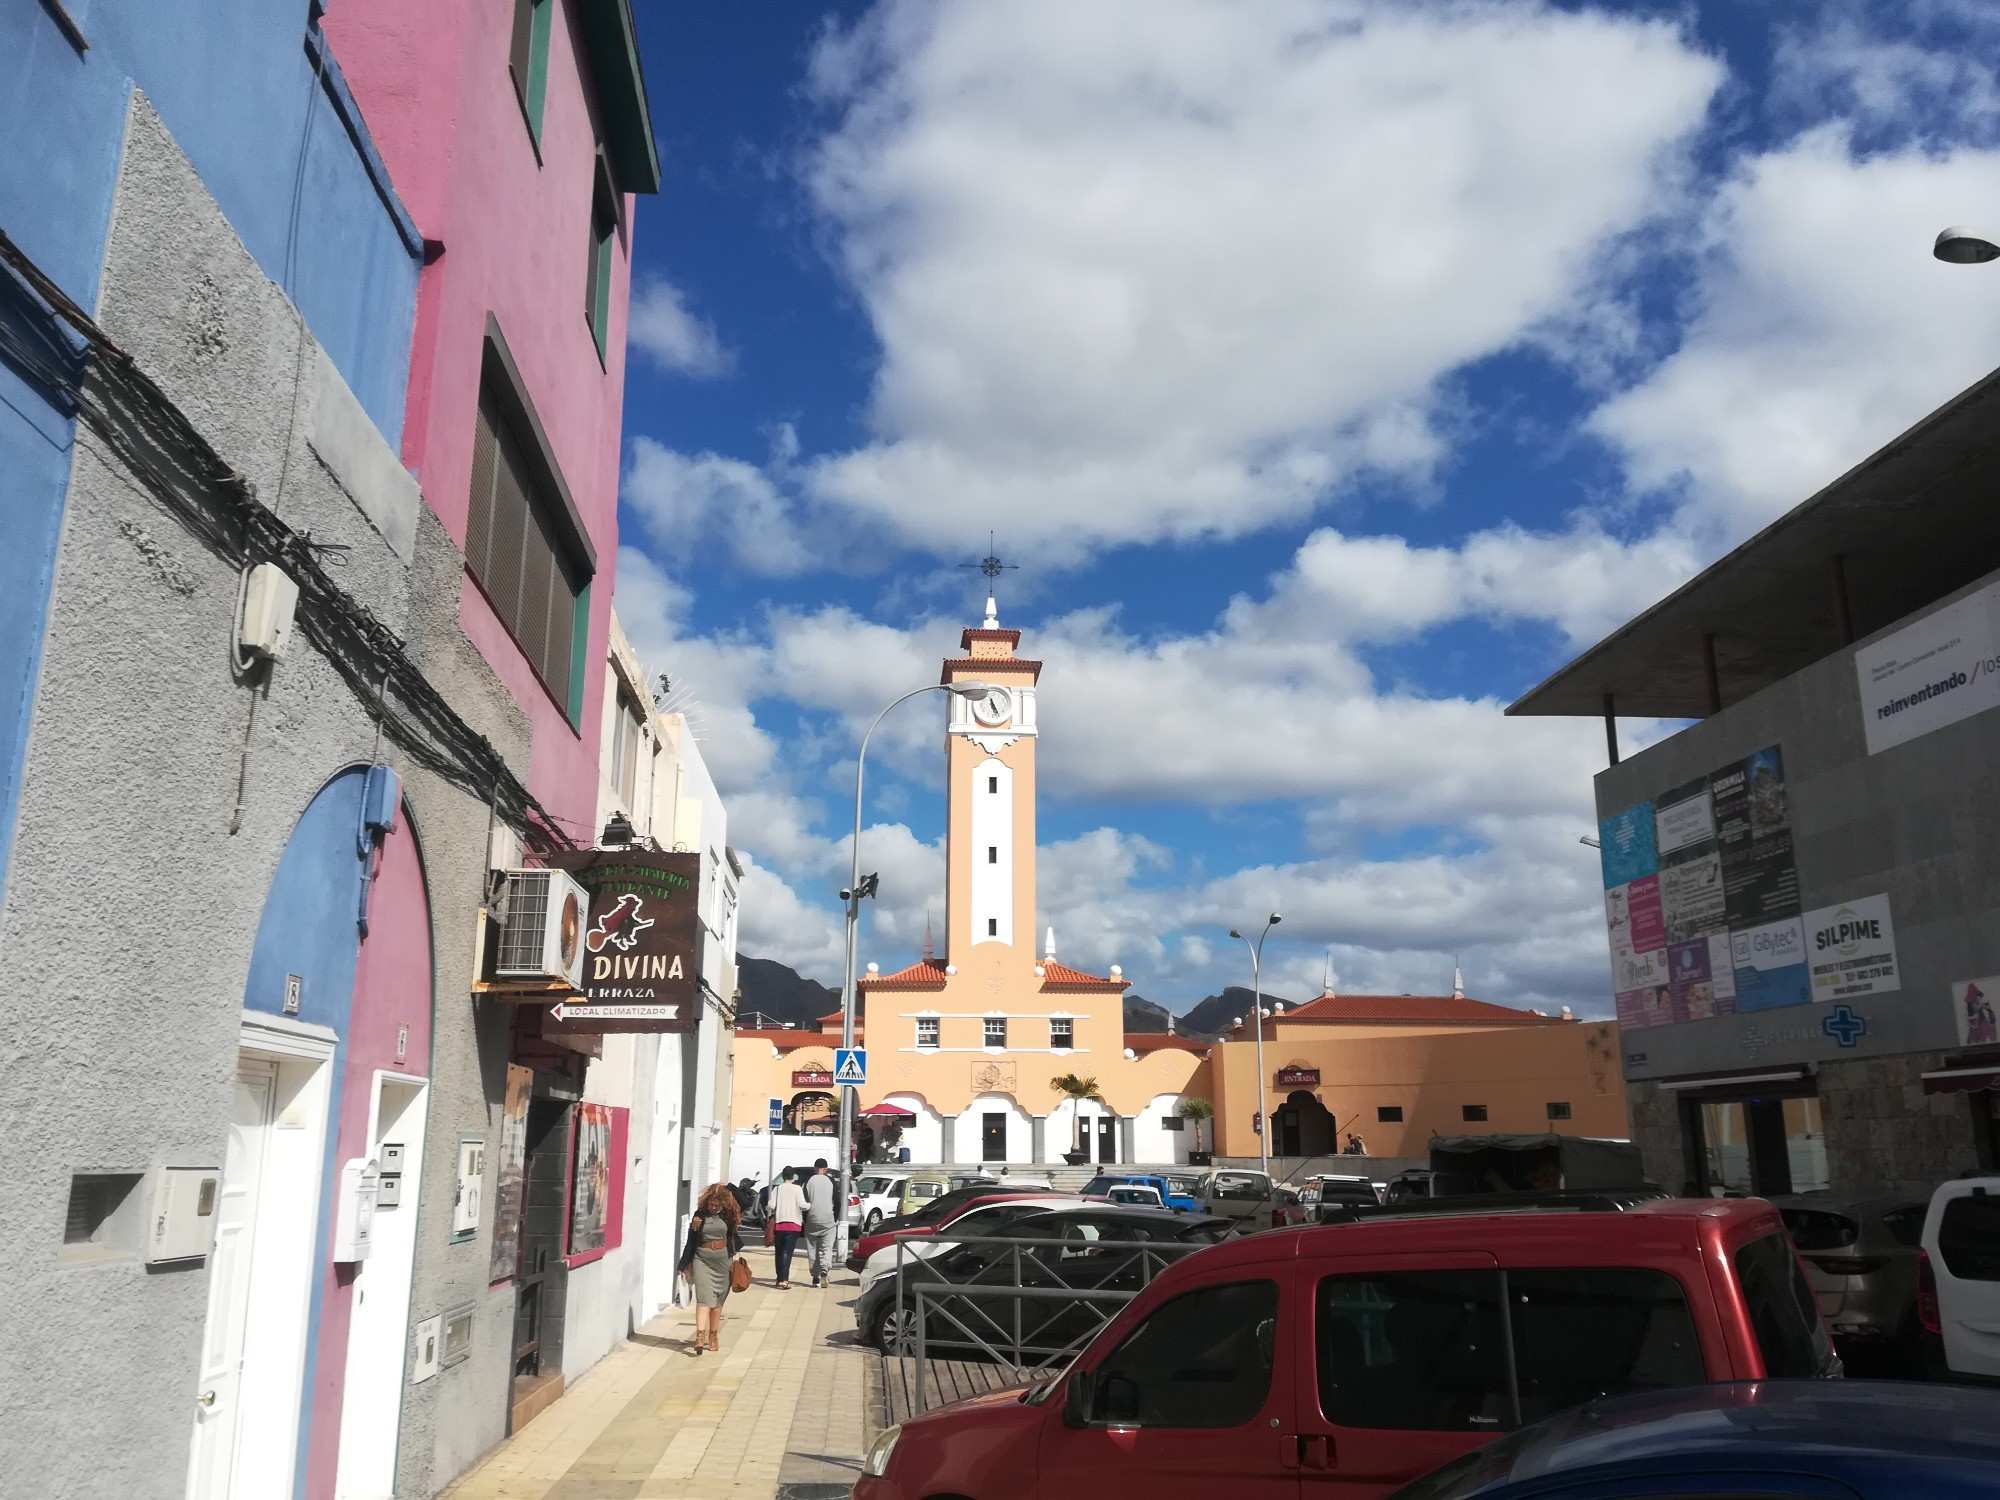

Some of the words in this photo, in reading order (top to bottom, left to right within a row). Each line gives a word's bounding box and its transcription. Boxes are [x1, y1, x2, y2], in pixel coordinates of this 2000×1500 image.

[1816, 919, 1881, 950] SILPIME
[593, 954, 684, 980] DIVINA
[290, 983, 297, 1004] 8
[570, 1007, 600, 1015] LOCAL
[603, 1007, 666, 1016] CLIMATIZADO
[400, 1032, 405, 1053] 6
[1284, 1075, 1316, 1083] ENTRADA
[769, 1109, 781, 1118] TAXI
